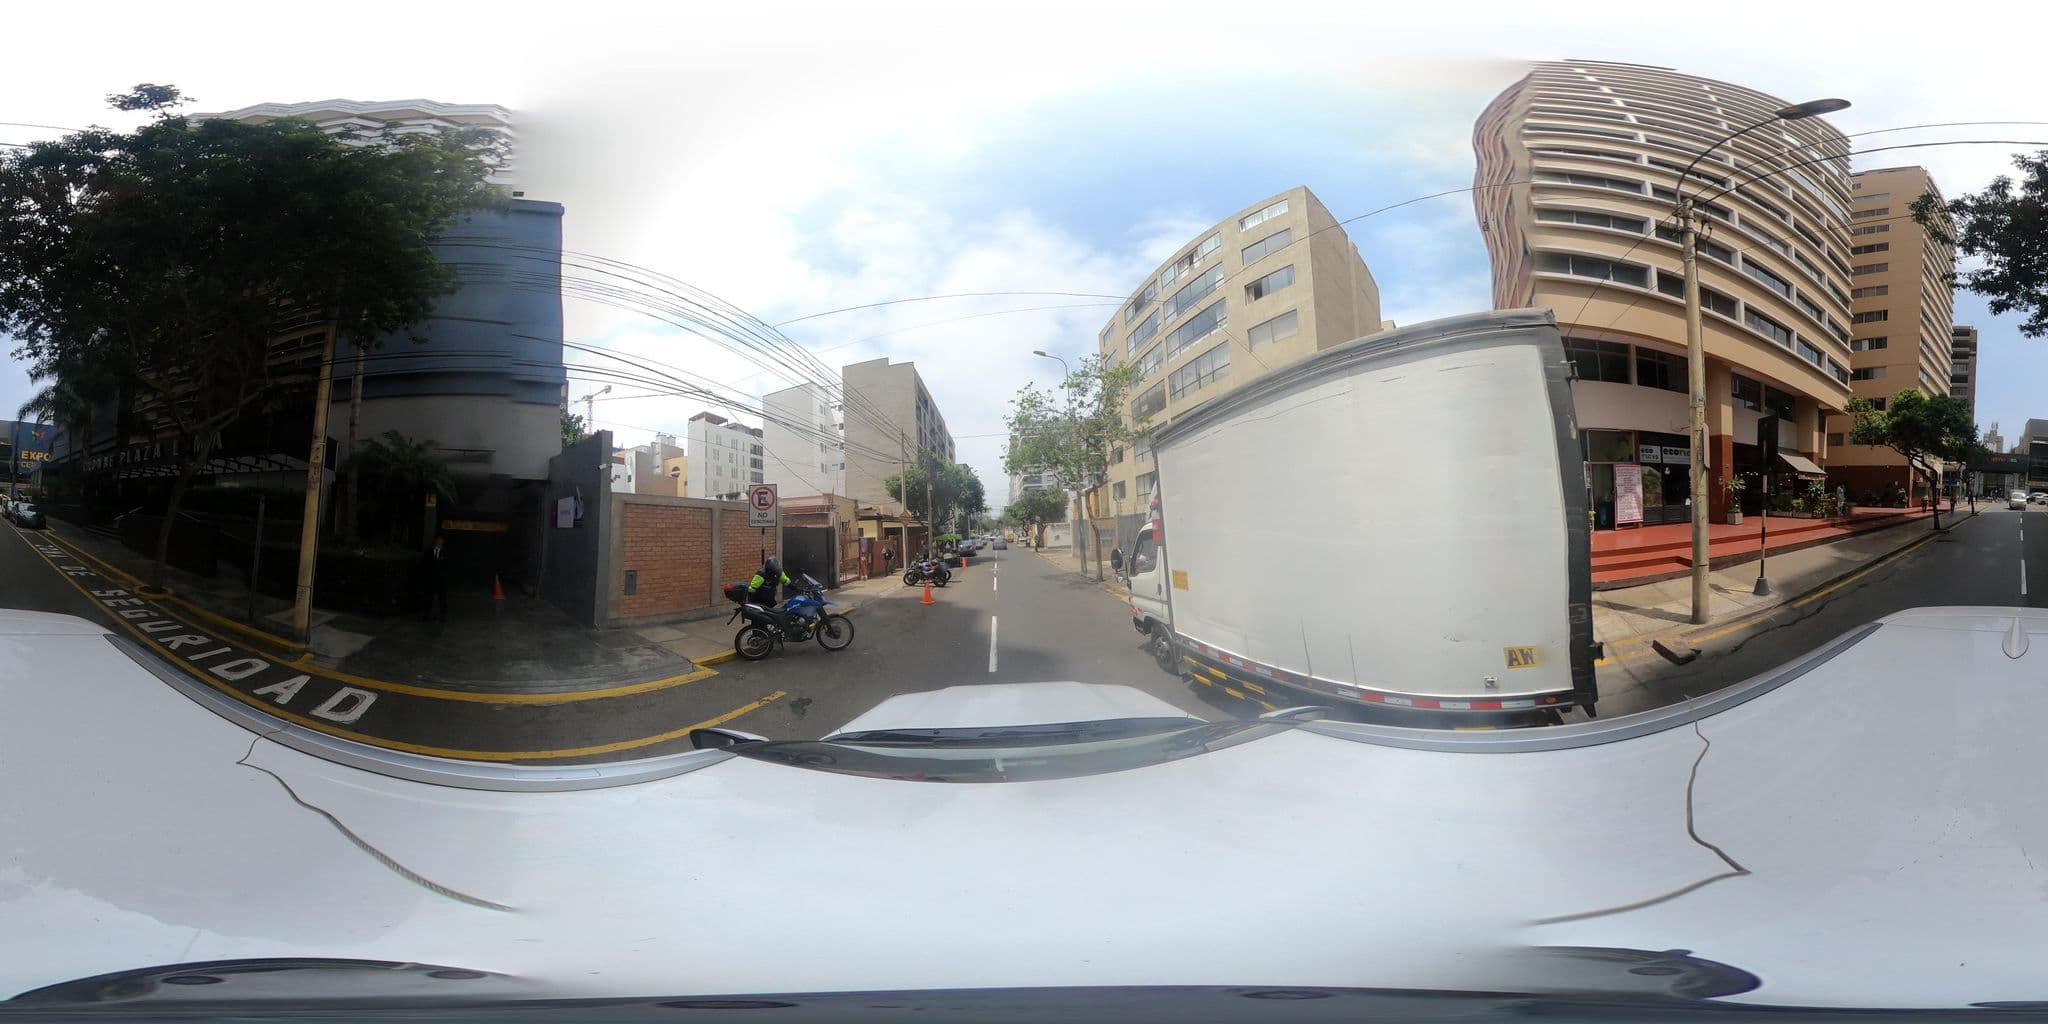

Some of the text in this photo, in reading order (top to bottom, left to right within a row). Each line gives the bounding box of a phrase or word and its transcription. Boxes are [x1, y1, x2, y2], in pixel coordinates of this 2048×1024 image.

[21, 450, 49, 462] EXPO
[119, 442, 161, 464] PLAZA
[91, 589, 378, 724] SEGURIDAD
[1507, 648, 1536, 667] AW
